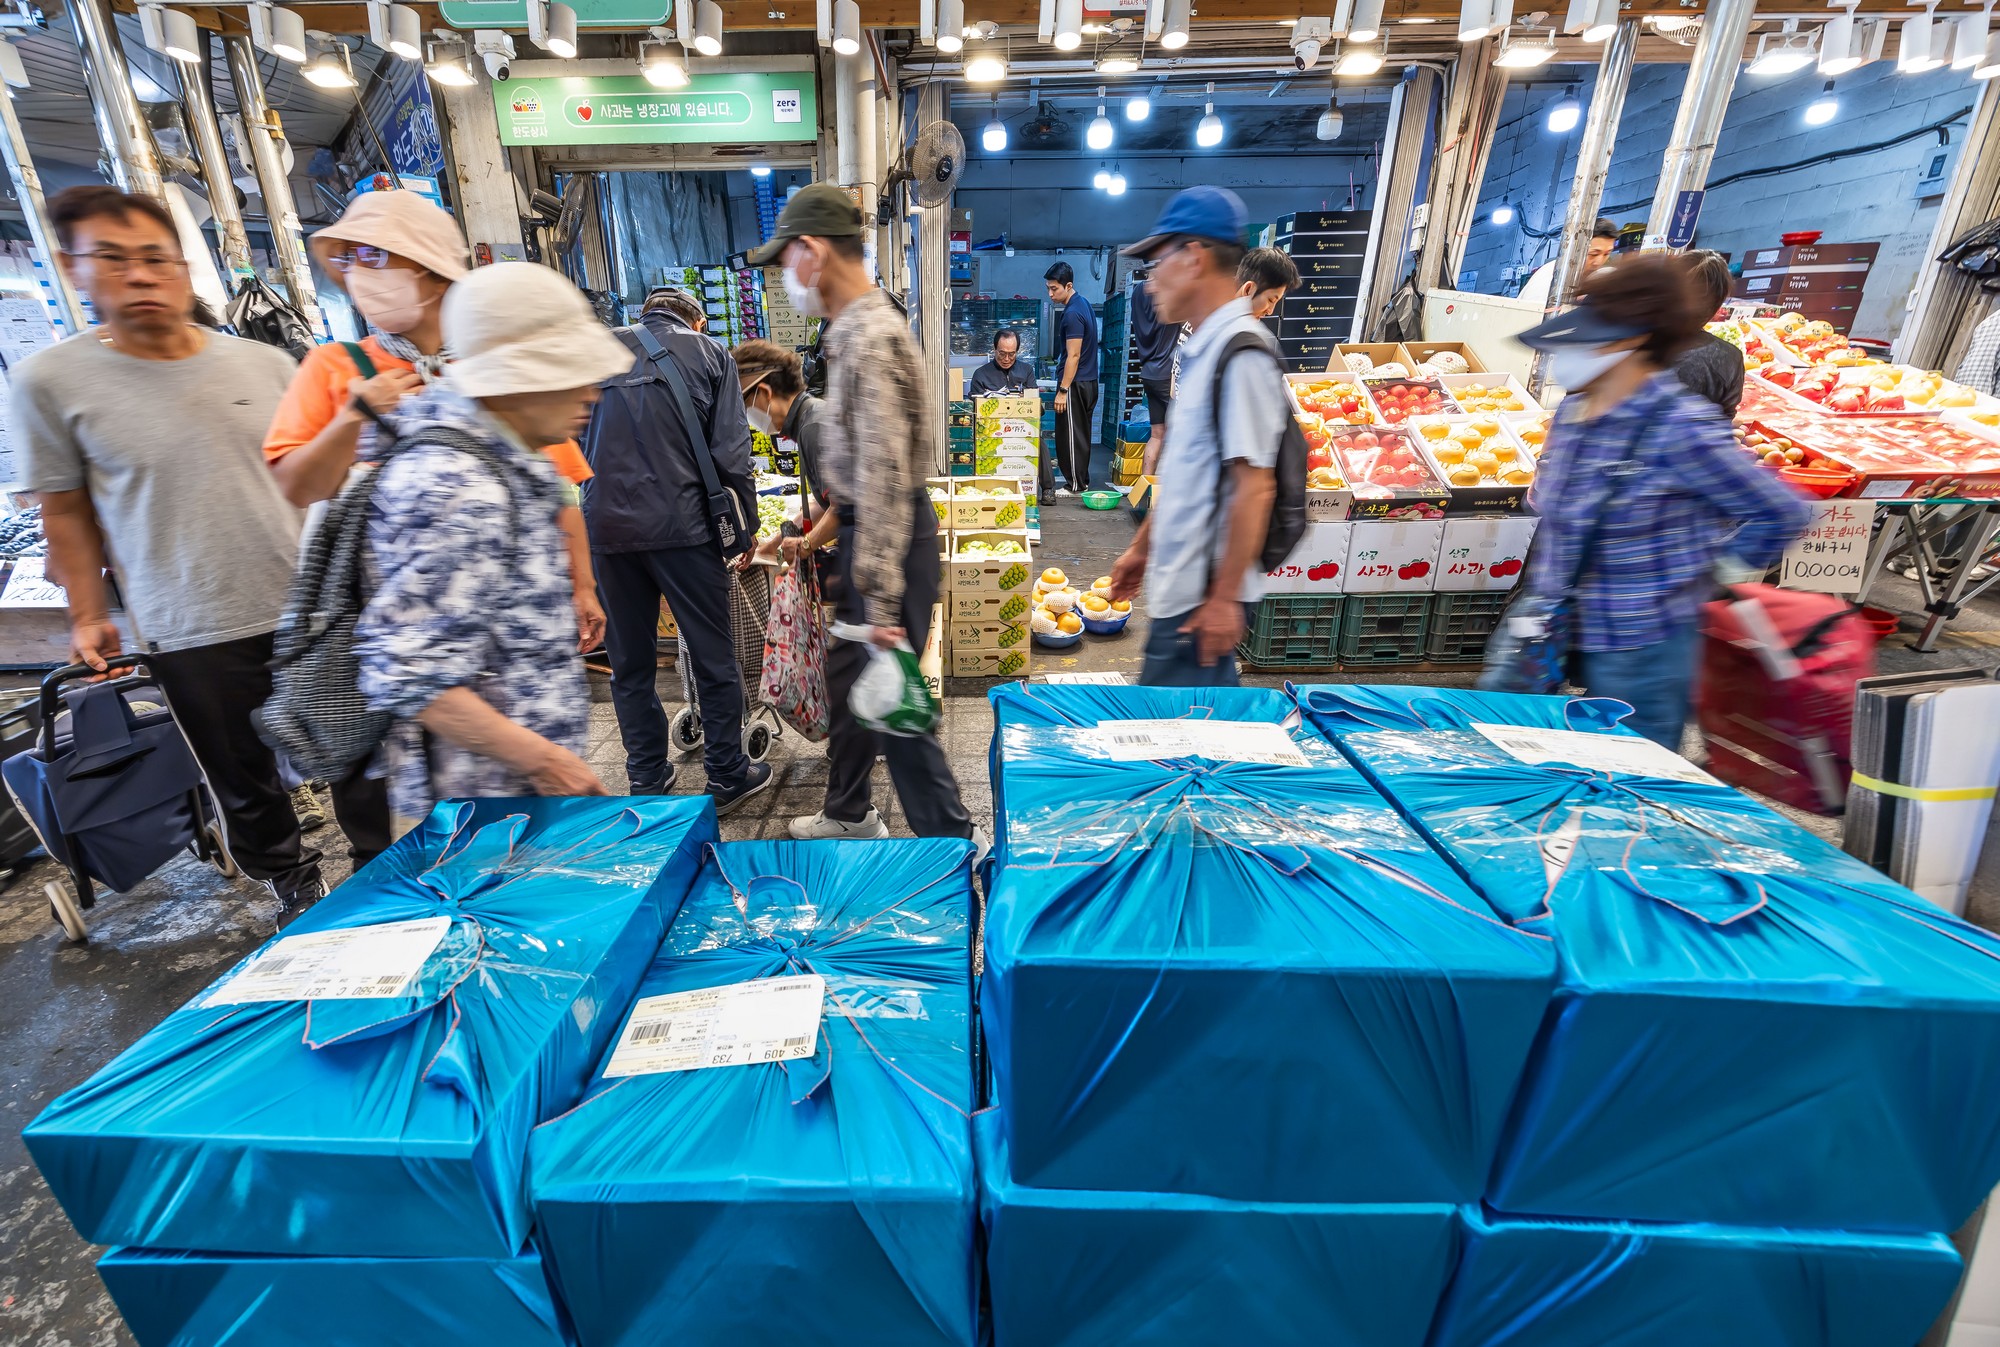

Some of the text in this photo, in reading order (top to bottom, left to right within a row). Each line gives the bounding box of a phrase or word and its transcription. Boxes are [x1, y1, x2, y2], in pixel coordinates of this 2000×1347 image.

[600, 102, 734, 118] 사과는 냉장고에 있습니다.
[512, 126, 548, 138] 한도상사
[1365, 504, 1390, 514] 사과
[1267, 564, 1303, 578] 사과
[1357, 565, 1394, 577] 사과
[1448, 562, 1485, 575] 사과
[303, 985, 397, 997] MH 580 C 321
[764, 1049, 785, 1060] 409
[793, 1046, 807, 1056] SS
[712, 1054, 733, 1065] 733
